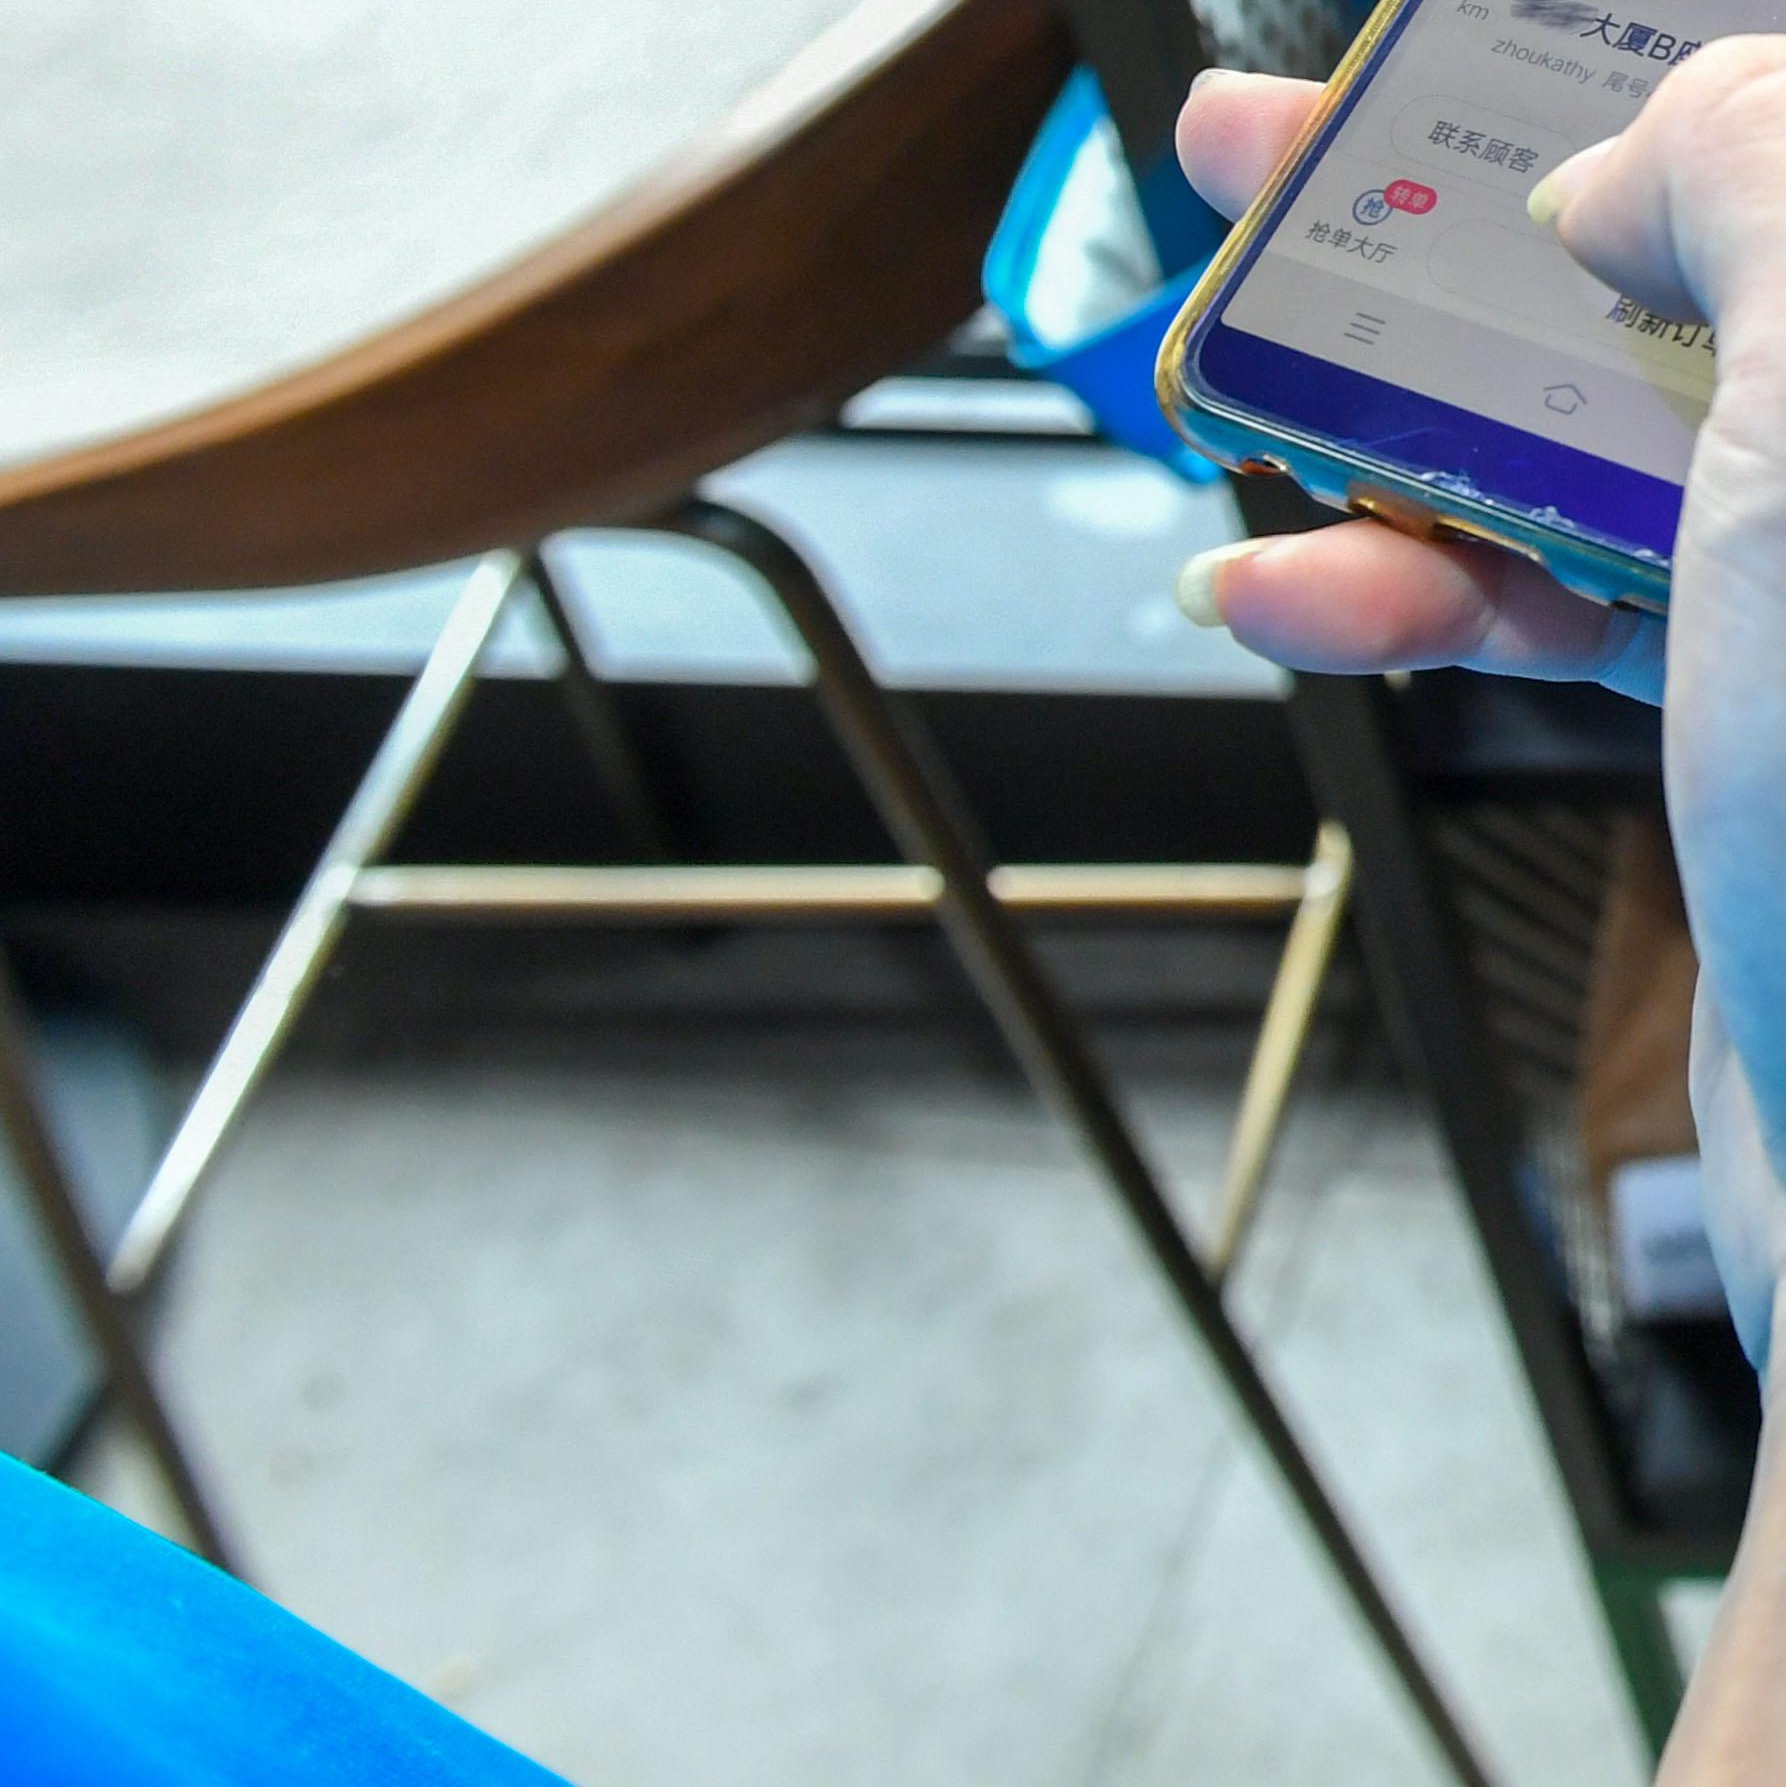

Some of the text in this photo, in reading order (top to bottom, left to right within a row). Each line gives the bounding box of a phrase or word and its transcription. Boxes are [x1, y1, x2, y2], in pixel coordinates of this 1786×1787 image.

[1489, 37, 1656, 101] zhoukathy 尾号
[1427, 120, 1540, 174] 联系顾客
[1304, 219, 1400, 264] 抢单大厅
